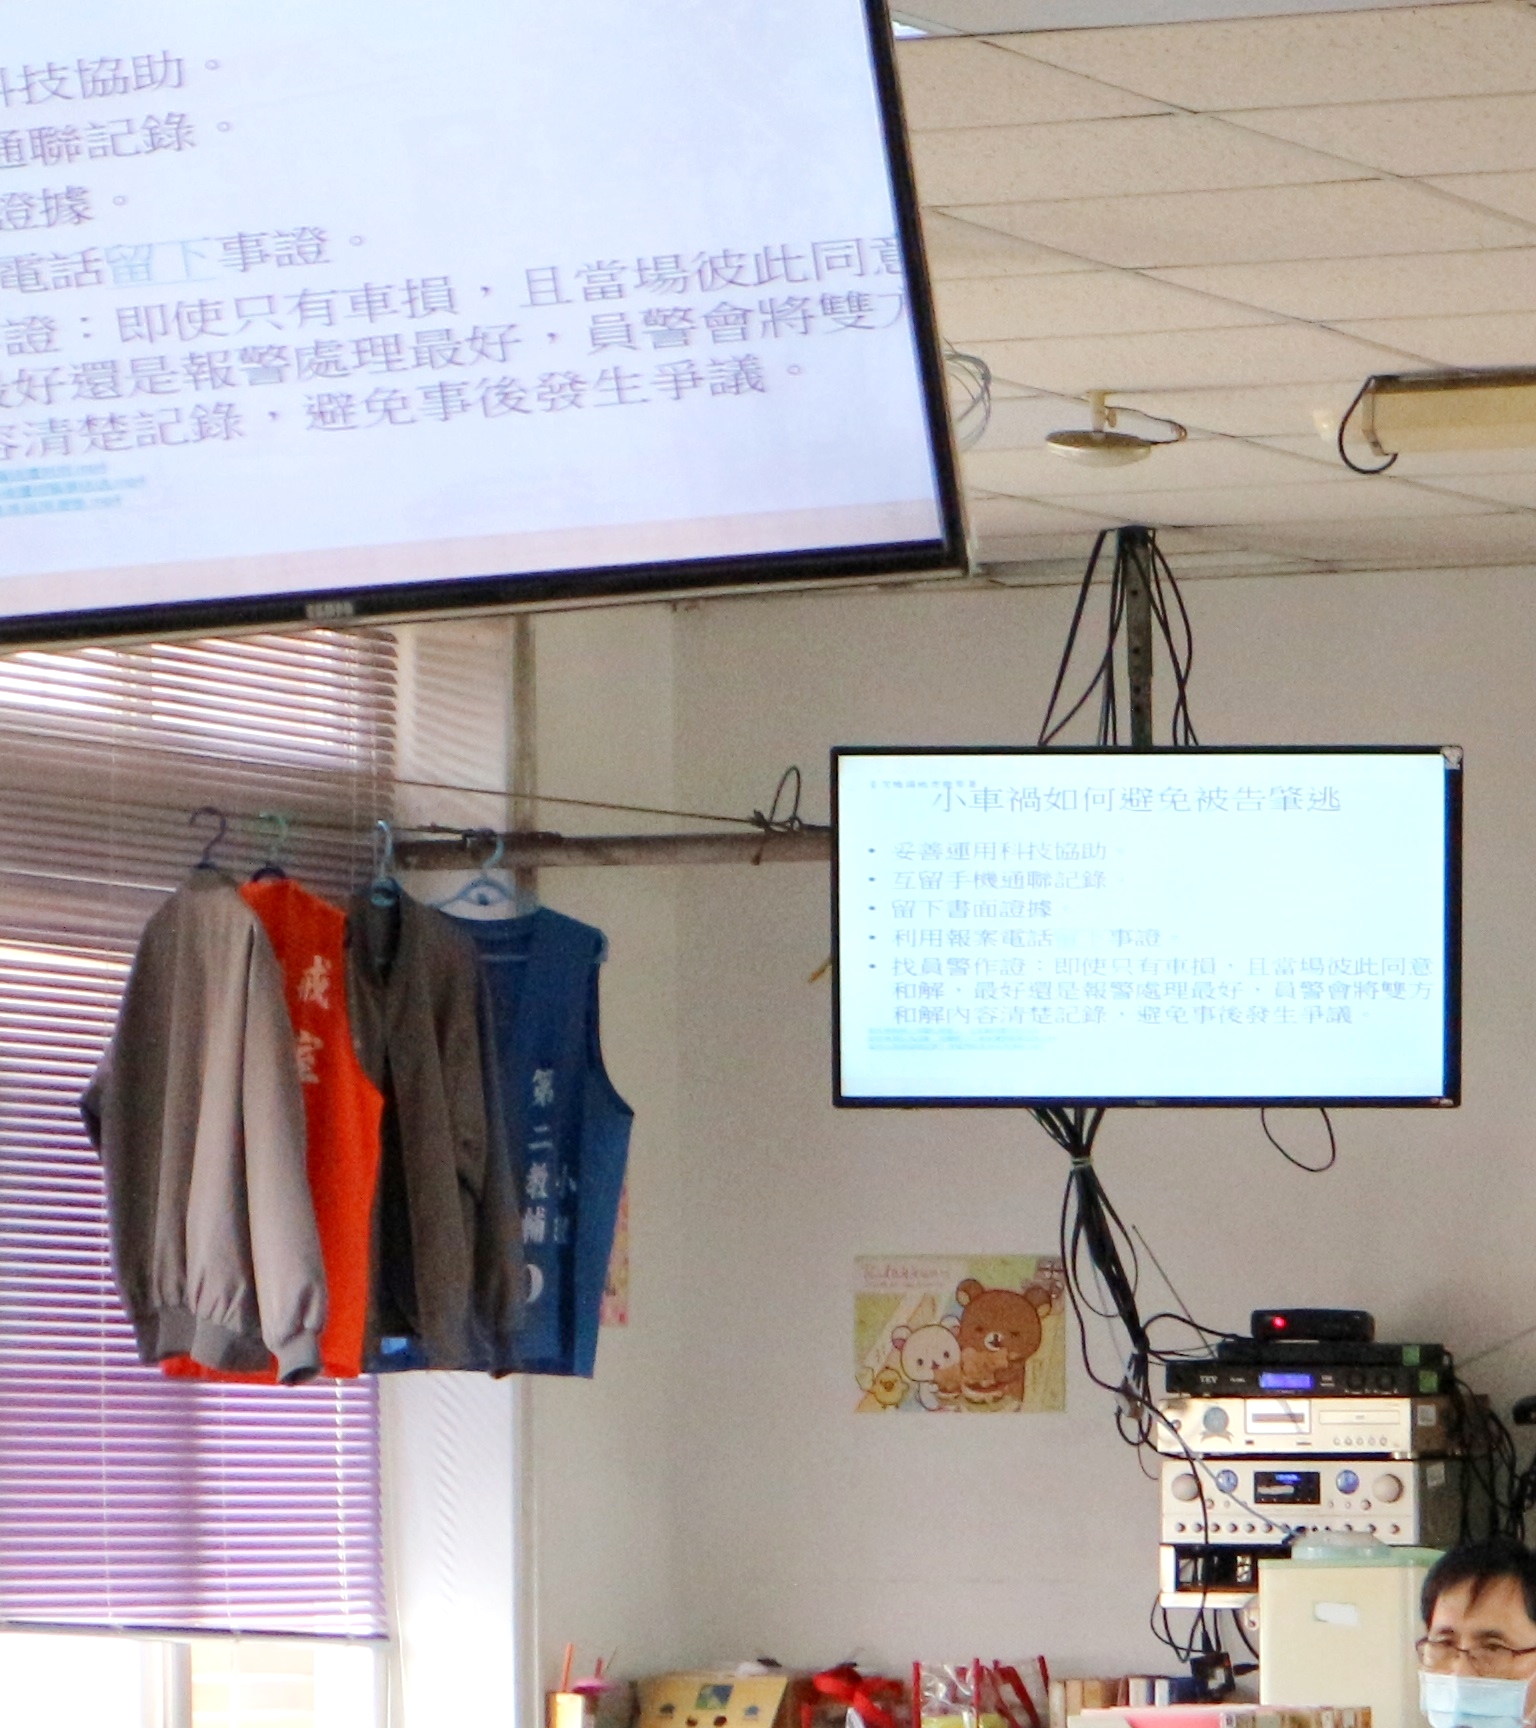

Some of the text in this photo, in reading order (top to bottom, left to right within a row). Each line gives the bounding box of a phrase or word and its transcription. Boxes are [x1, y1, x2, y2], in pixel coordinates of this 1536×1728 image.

[932, 786, 1342, 813] 小車禍如何避免被告肇逃
